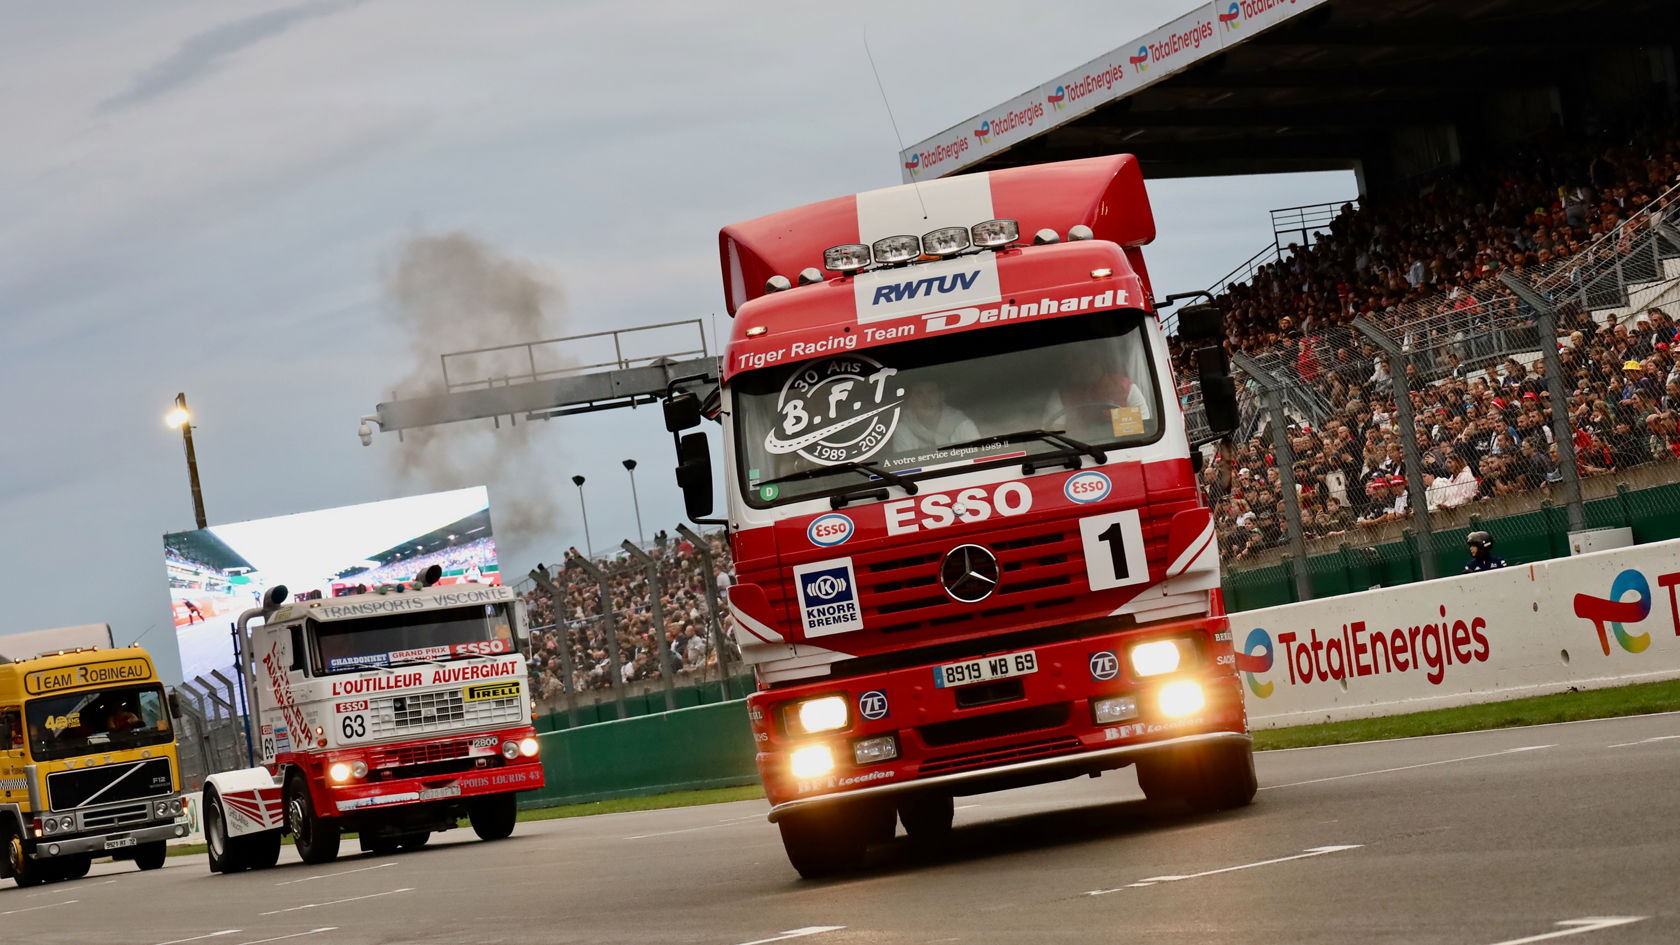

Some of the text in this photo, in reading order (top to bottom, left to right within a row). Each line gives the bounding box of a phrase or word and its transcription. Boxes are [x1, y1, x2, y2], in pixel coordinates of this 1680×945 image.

[1148, 20, 1213, 64] TotalEnergies
[1065, 63, 1123, 103] TotalEnergies
[990, 102, 1044, 137] TotalEnergies
[919, 135, 969, 169] TotalEnergies
[872, 270, 981, 305] RWTUV
[738, 289, 1129, 369] Tiger Racing Team Dehnhardt
[794, 360, 862, 393] 30 Ans
[782, 367, 905, 435] B.F.T.
[813, 445, 847, 461] 1989
[858, 423, 887, 452] 2019
[883, 458, 891, 468] A
[892, 456, 917, 467] votre
[917, 450, 949, 463] service
[950, 445, 979, 460] depuis
[766, 487, 773, 497] D
[883, 481, 1033, 536] ESSO
[1097, 522, 1129, 581] 1
[321, 588, 510, 619] TRANSPORTS VISCONTE
[806, 602, 856, 619] KNORR
[808, 612, 858, 629] BREMSE
[392, 646, 447, 660] GRAND PRIX
[455, 640, 504, 656] ESSO
[1278, 604, 1490, 686] TotalEnergies
[32, 664, 144, 691] TEAM ROBINEAU
[332, 660, 518, 696] L'OUTILLEUR AUVERGNAT
[945, 661, 982, 683] 8919
[988, 658, 1009, 676] WB
[1014, 653, 1035, 672] 69
[1092, 655, 1117, 676] ZF
[469, 682, 520, 700] PIRELLI
[861, 695, 886, 716] ZF
[342, 714, 366, 739] 63
[1104, 722, 1145, 741] BFT
[264, 737, 275, 760] 63
[474, 736, 498, 749] 2800
[492, 773, 527, 786] LOURDS
[529, 771, 541, 781] 43
[838, 770, 895, 787] Location
